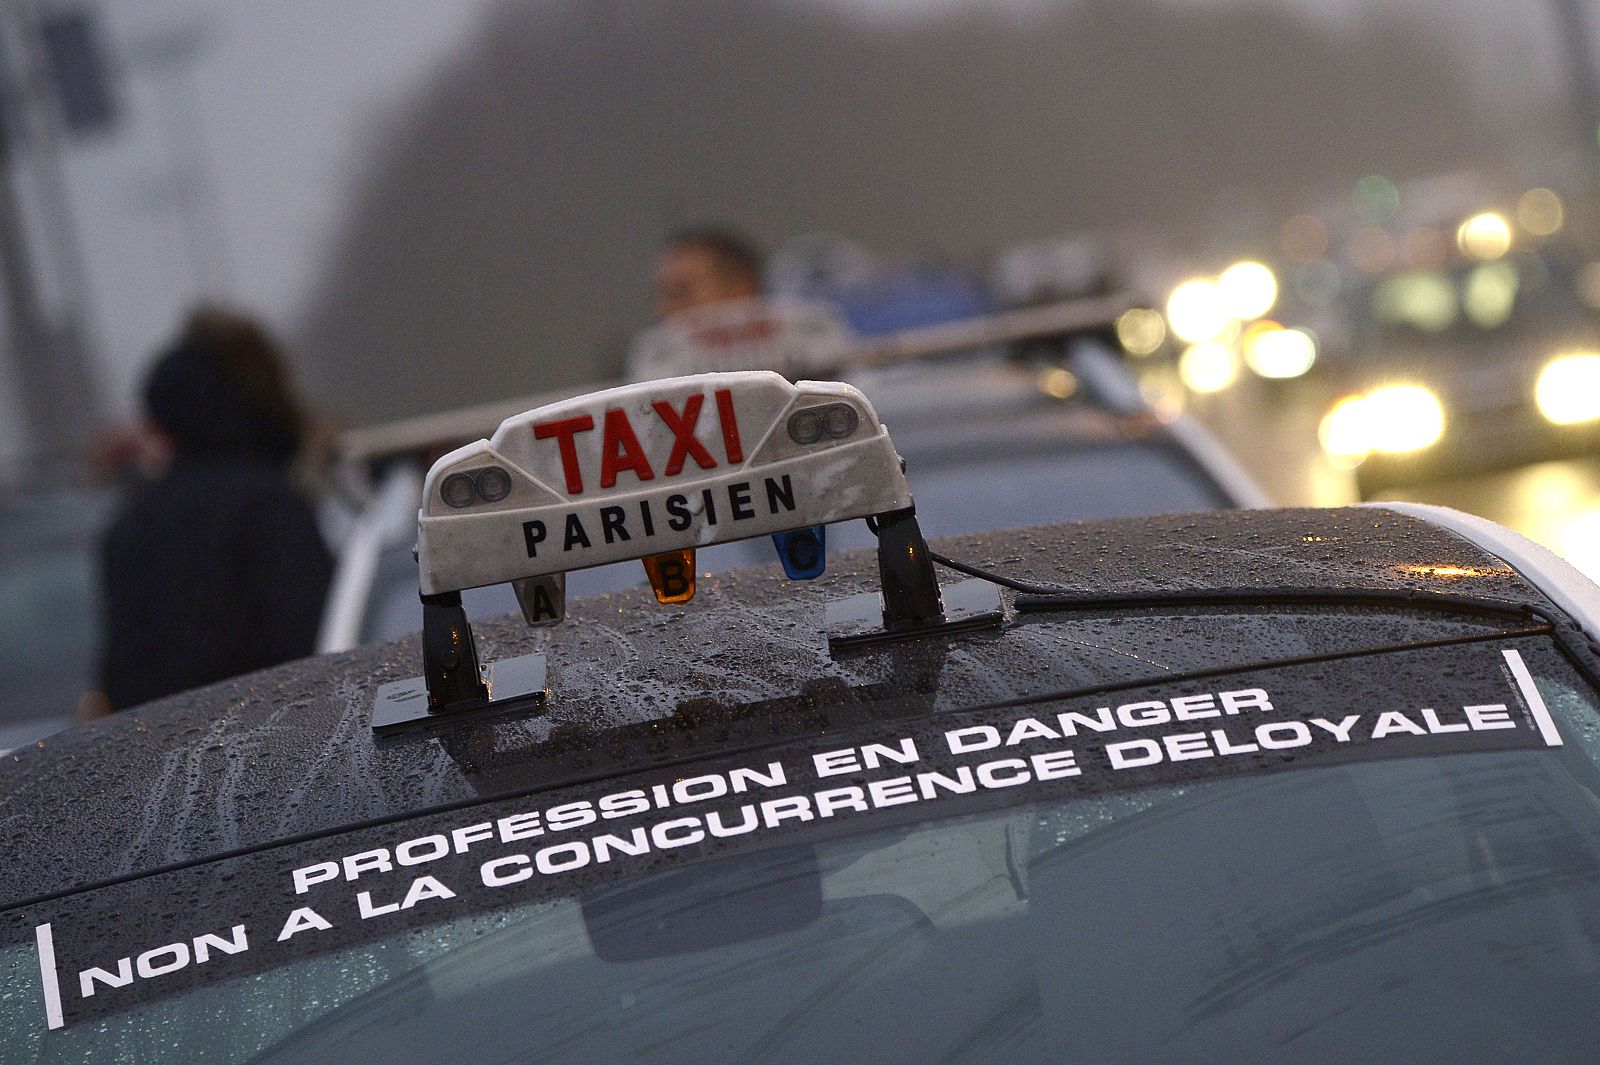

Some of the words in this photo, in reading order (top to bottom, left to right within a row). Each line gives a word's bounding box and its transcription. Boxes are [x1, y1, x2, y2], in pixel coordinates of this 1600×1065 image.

[534, 389, 743, 494] TAXI
[522, 474, 796, 558] PARISIEN
[787, 533, 819, 570] C
[533, 586, 558, 622] A
[661, 561, 690, 598] B
[292, 761, 787, 895] PROFESSION
[813, 737, 920, 778] EN
[944, 688, 1274, 755] DANGER
[78, 924, 249, 998] NON
[277, 906, 333, 942] A
[356, 875, 457, 920] LA
[480, 749, 1082, 888] CONCURRENCE
[1104, 703, 1517, 770] DELOYALE
